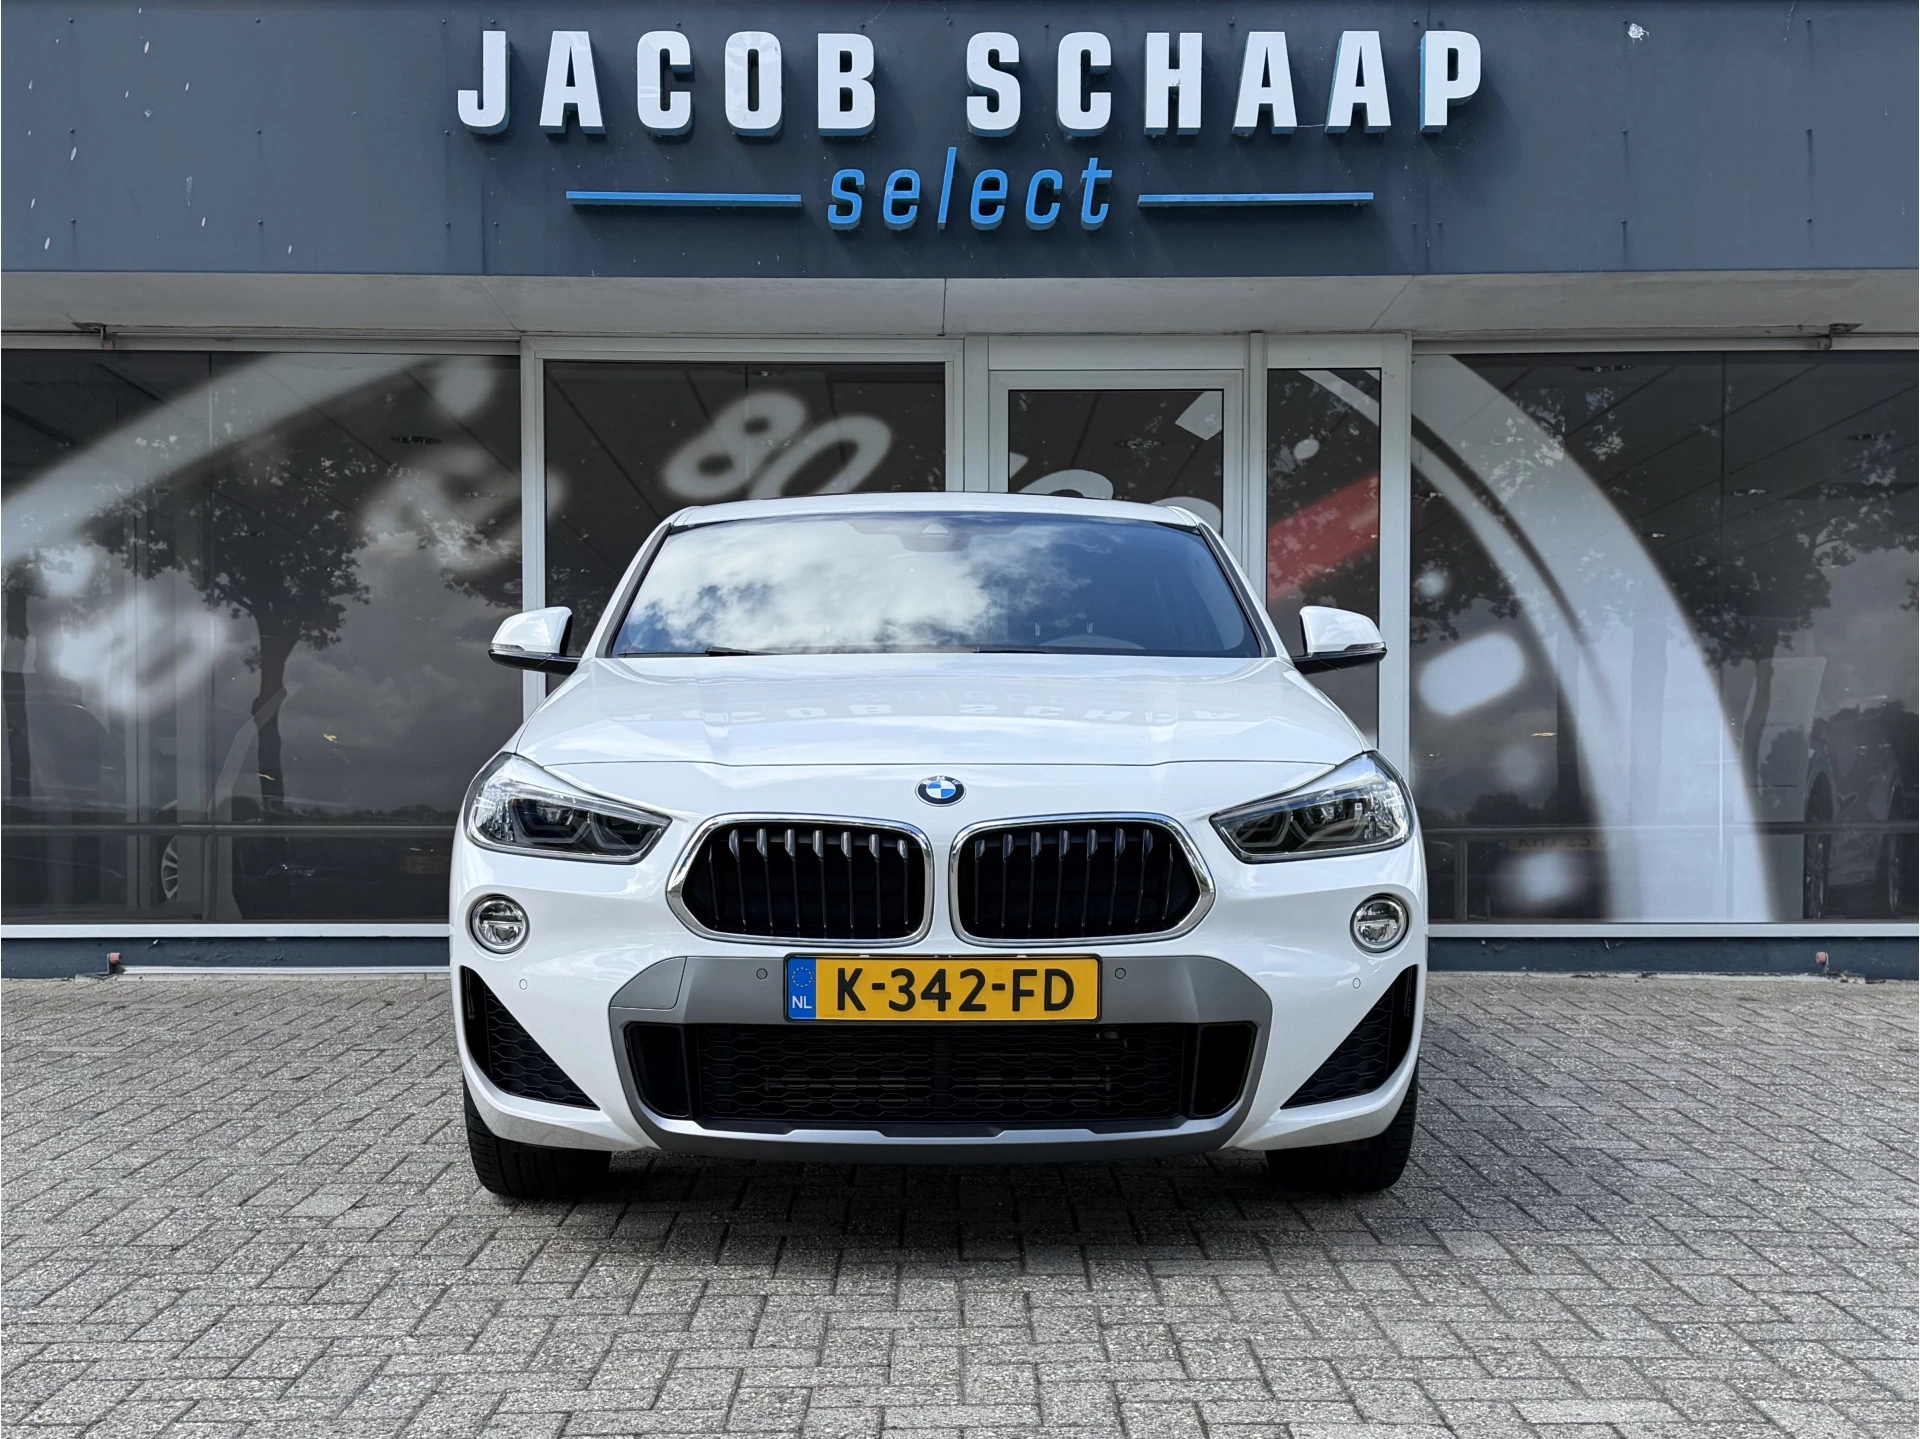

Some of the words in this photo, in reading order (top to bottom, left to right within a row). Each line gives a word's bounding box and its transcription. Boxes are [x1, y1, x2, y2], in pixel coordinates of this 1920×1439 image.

[457, 30, 876, 135] JACOB
[966, 30, 1482, 136] SCHAAP
[827, 146, 1113, 230] select
[792, 996, 813, 1009] NL
[836, 967, 1075, 1012] K-342-FD
